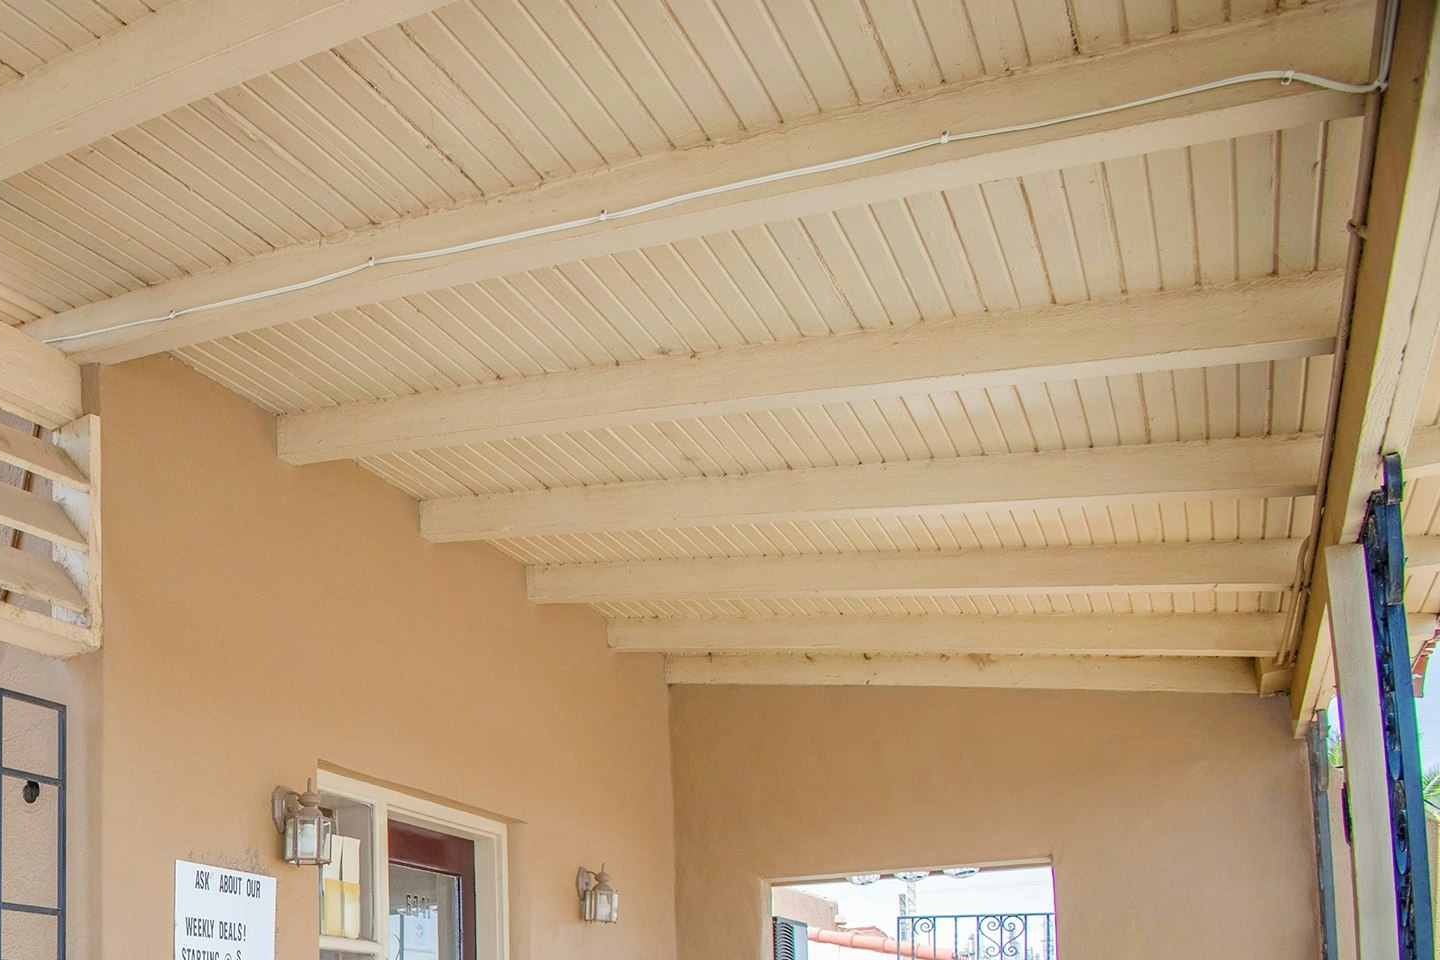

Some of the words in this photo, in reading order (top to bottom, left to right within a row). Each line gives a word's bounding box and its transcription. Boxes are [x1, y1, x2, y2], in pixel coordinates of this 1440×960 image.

[195, 870, 210, 891] ASK
[219, 874, 242, 896] ABOUT
[246, 879, 261, 898] OUR
[185, 916, 215, 939] WEEKLY
[219, 921, 247, 942] DEALS!
